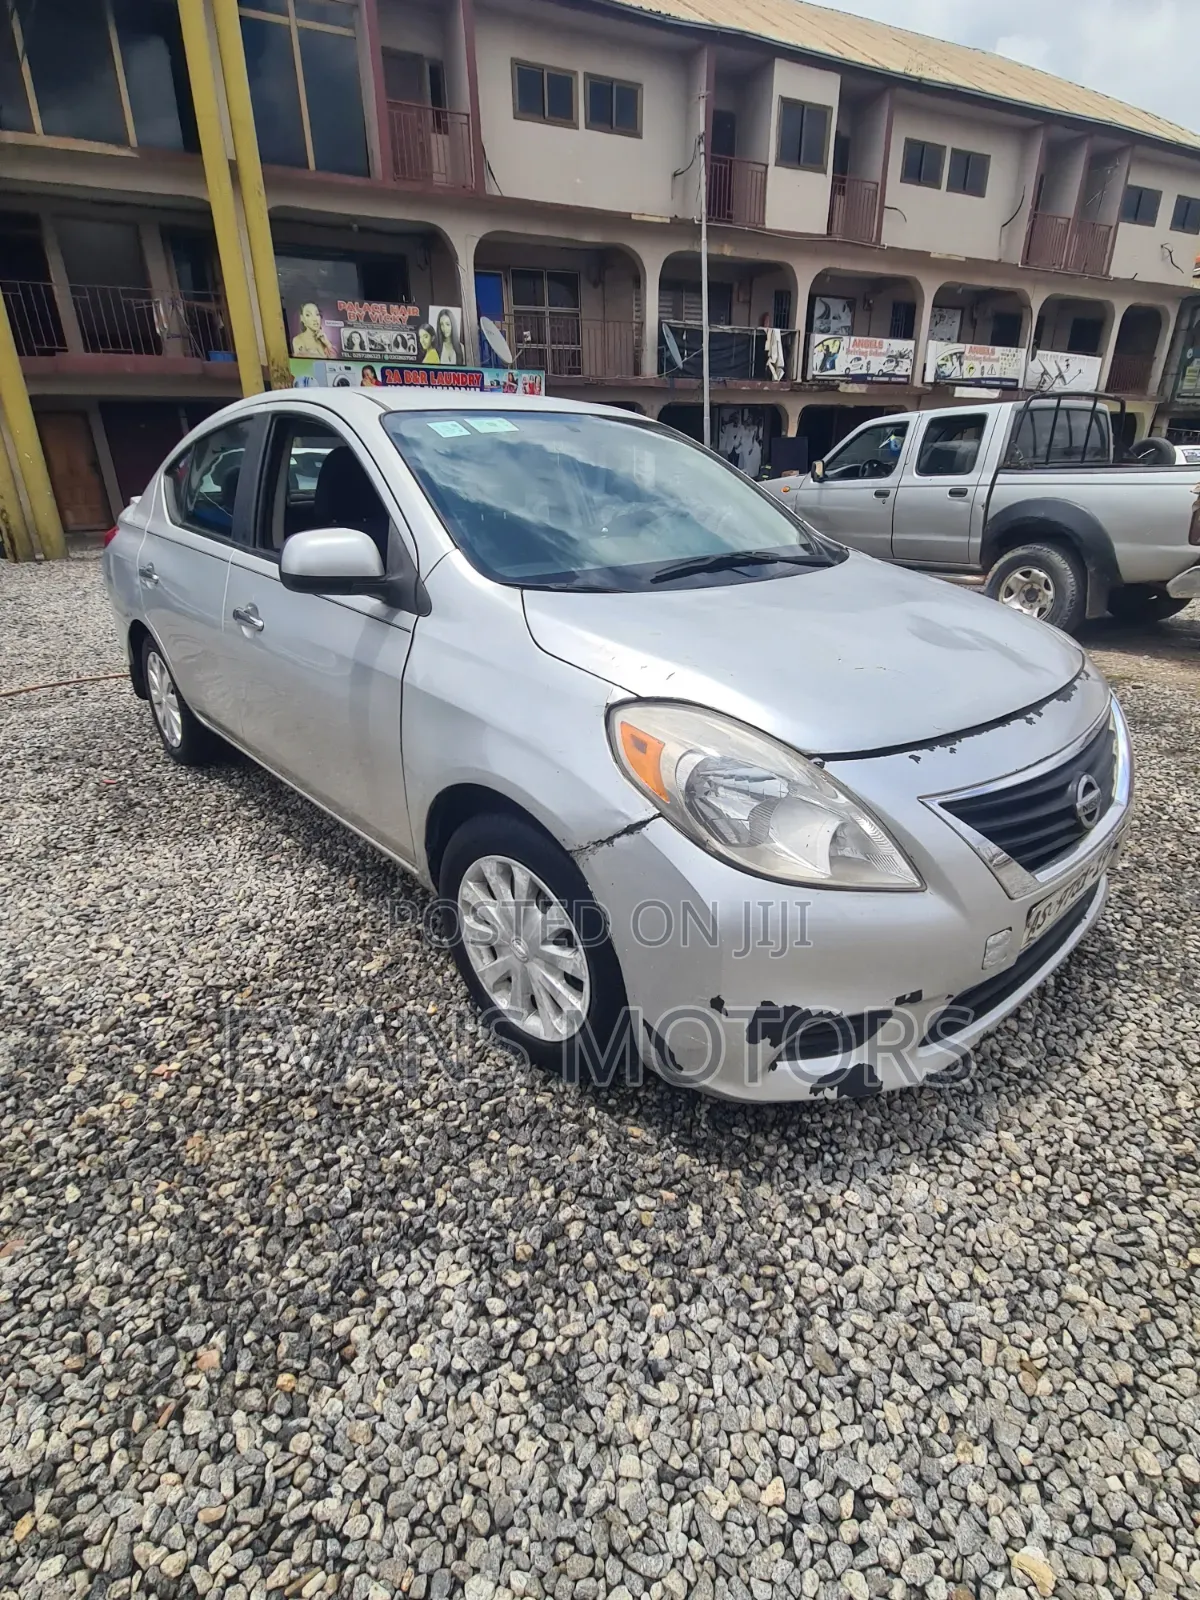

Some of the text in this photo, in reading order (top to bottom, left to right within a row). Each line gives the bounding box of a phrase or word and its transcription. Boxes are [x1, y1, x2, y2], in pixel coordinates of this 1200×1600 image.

[337, 301, 420, 316] PALACE HAIR
[347, 311, 409, 325] BY VICKY
[385, 369, 482, 387] 2A B&R LAUNDRY
